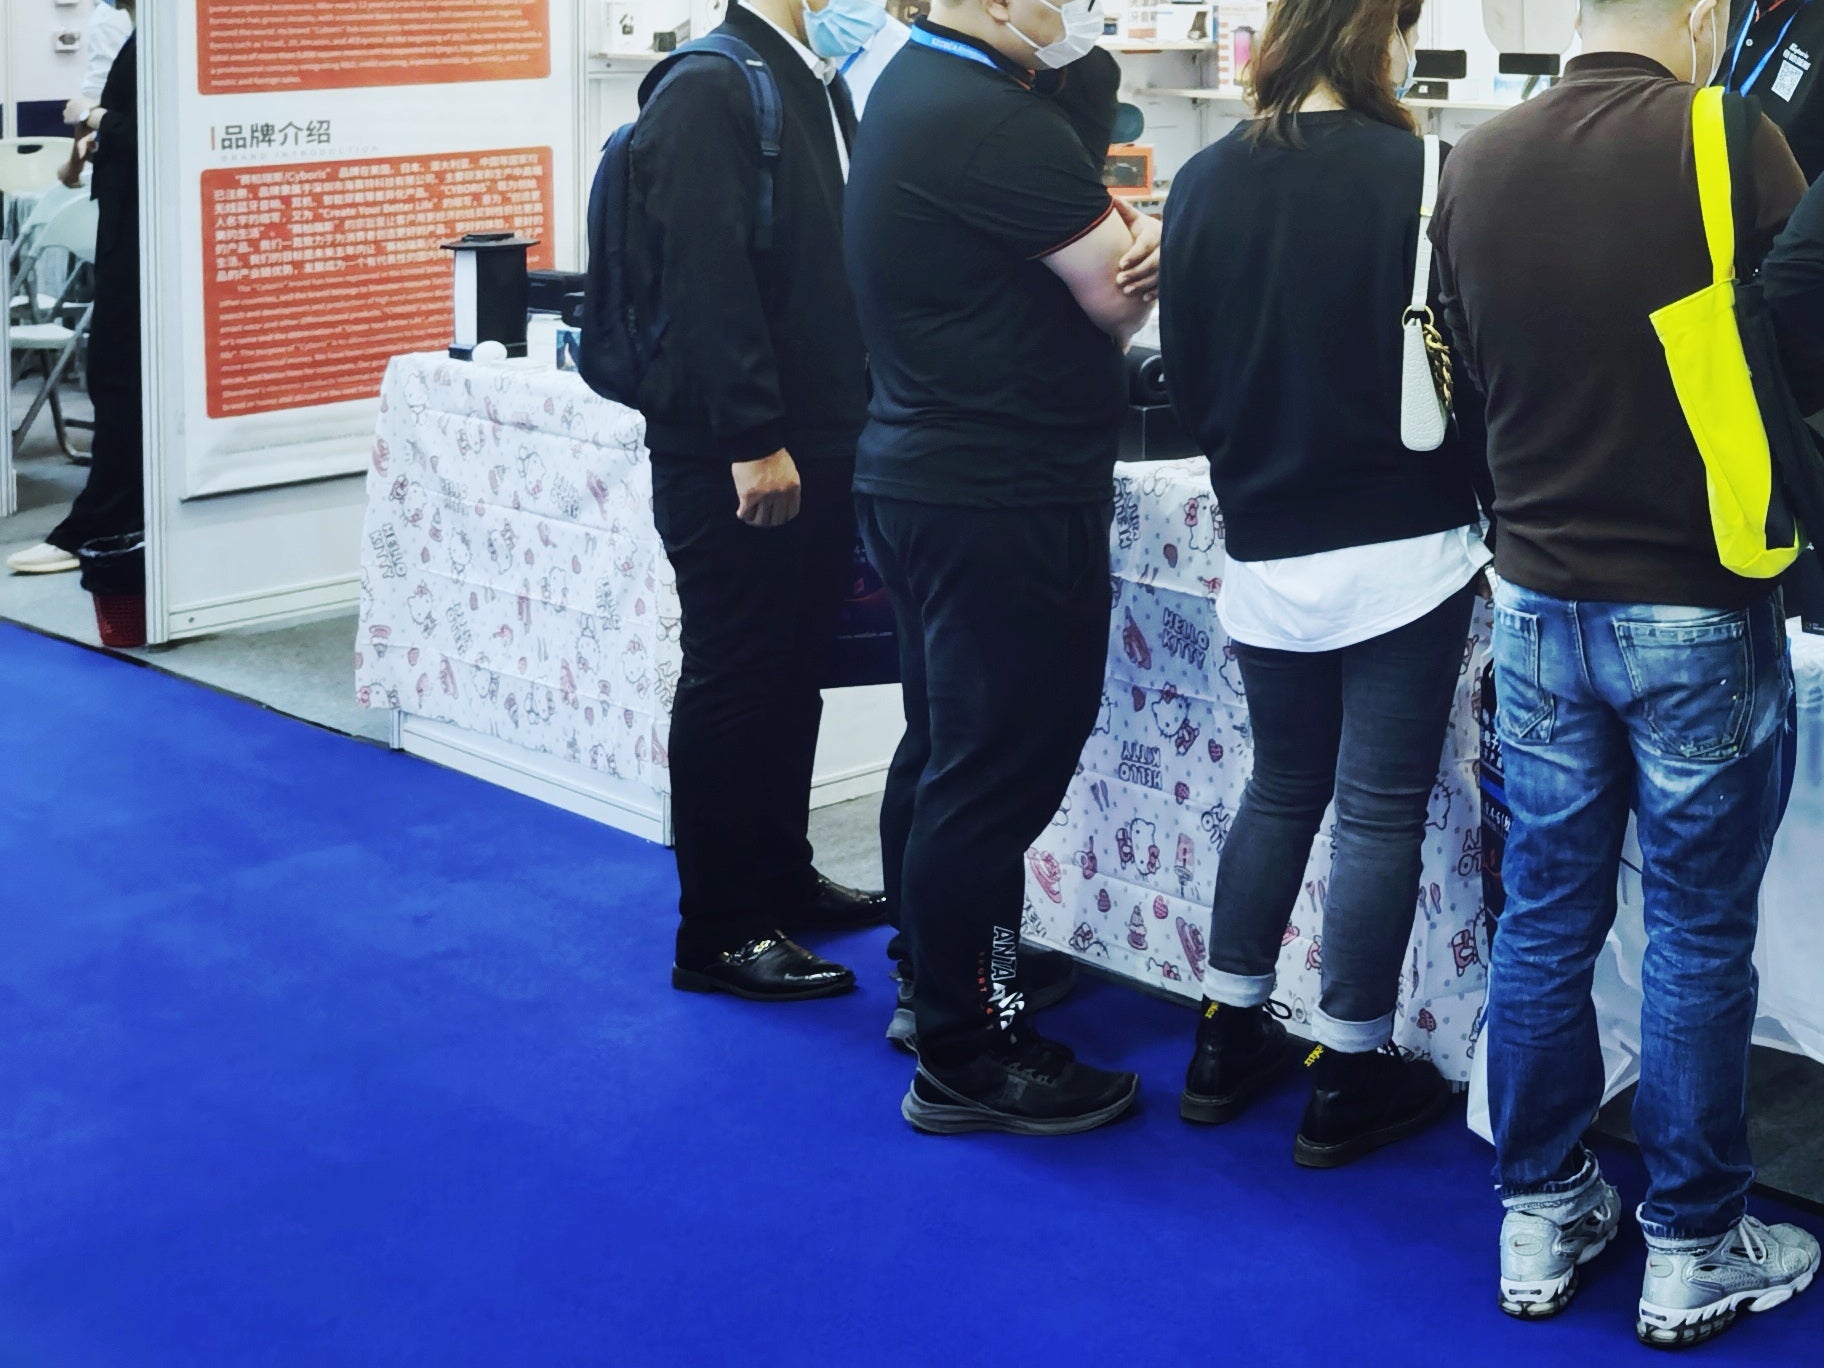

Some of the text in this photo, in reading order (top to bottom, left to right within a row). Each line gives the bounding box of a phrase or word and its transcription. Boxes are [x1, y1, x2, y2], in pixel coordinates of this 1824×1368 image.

[220, 120, 332, 151] 品牌介绍
[369, 529, 396, 579] KITTY
[382, 522, 408, 578] HELLO
[1163, 606, 1210, 652] HELLO
[1161, 633, 1206, 671] KITTY
[1120, 739, 1161, 766] KITTY
[1118, 762, 1163, 790] HELLO
[991, 925, 1017, 981] ANTA
